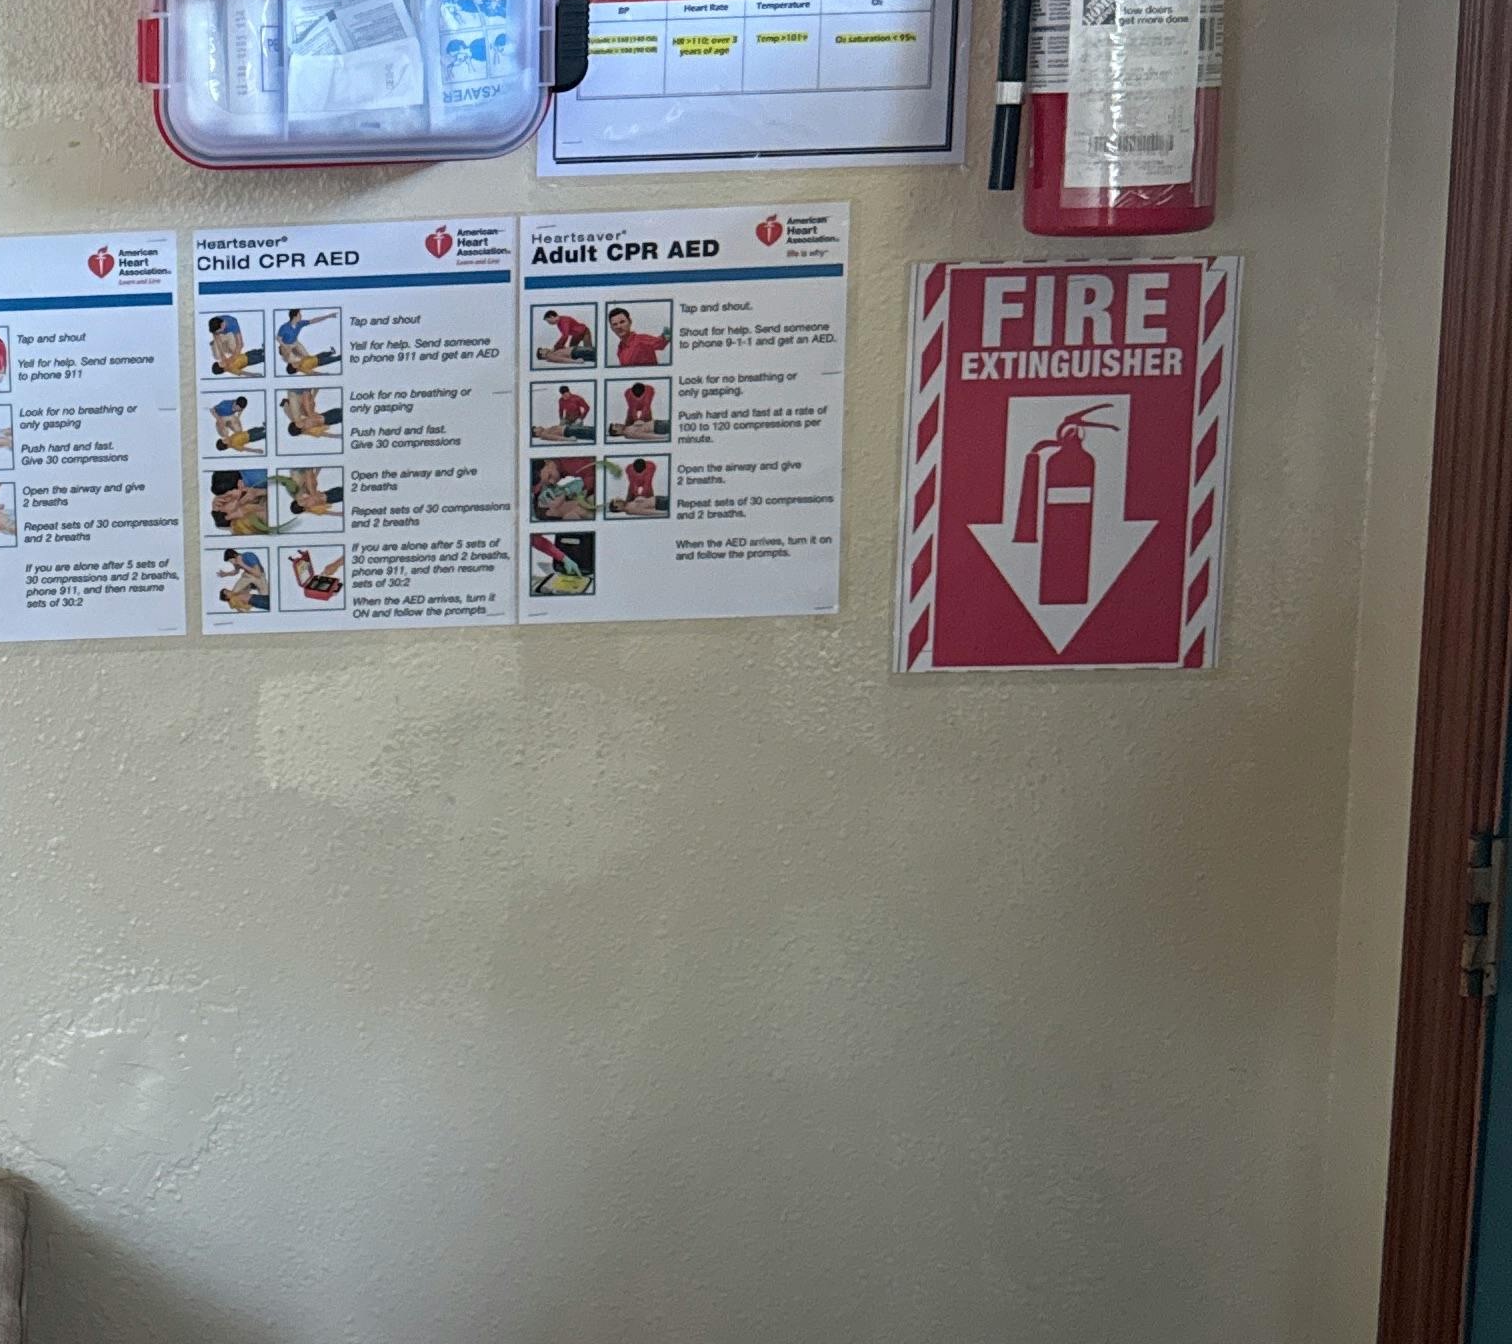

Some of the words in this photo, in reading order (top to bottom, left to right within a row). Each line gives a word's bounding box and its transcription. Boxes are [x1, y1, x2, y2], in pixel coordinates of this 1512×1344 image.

[757, 2, 810, 10] Temperature
[787, 225, 818, 236] Heart
[457, 237, 489, 247] Heart
[118, 248, 158, 257] American
[531, 245, 597, 264] Adult
[607, 242, 658, 261] CPR
[667, 239, 719, 259] AED
[118, 257, 150, 267] Heart
[197, 254, 250, 271] Child
[259, 253, 305, 269] CPR
[314, 251, 360, 266] AED
[680, 303, 698, 314] Tap
[700, 303, 719, 312] and
[982, 272, 1170, 348] FIRE
[350, 316, 368, 328] Tap
[369, 316, 390, 326] and
[392, 315, 421, 325] shout
[17, 334, 34, 345] Tap
[37, 333, 56, 344] and
[58, 333, 86, 343] shout
[18, 359, 35, 368] Yell
[38, 358, 52, 368] for
[81, 356, 107, 366] Send
[109, 356, 155, 365] someone
[961, 348, 1182, 380] EXTINGUISHER
[18, 372, 28, 381] to
[30, 371, 62, 382] phone
[64, 367, 82, 379] 911
[19, 408, 43, 417] Look
[46, 407, 60, 416] for
[78, 404, 124, 416] breathing
[127, 405, 138, 413] or
[20, 420, 41, 431] only
[43, 419, 82, 431] gasping
[21, 456, 43, 466] Give
[46, 455, 59, 465] 30
[61, 454, 128, 465] compressions
